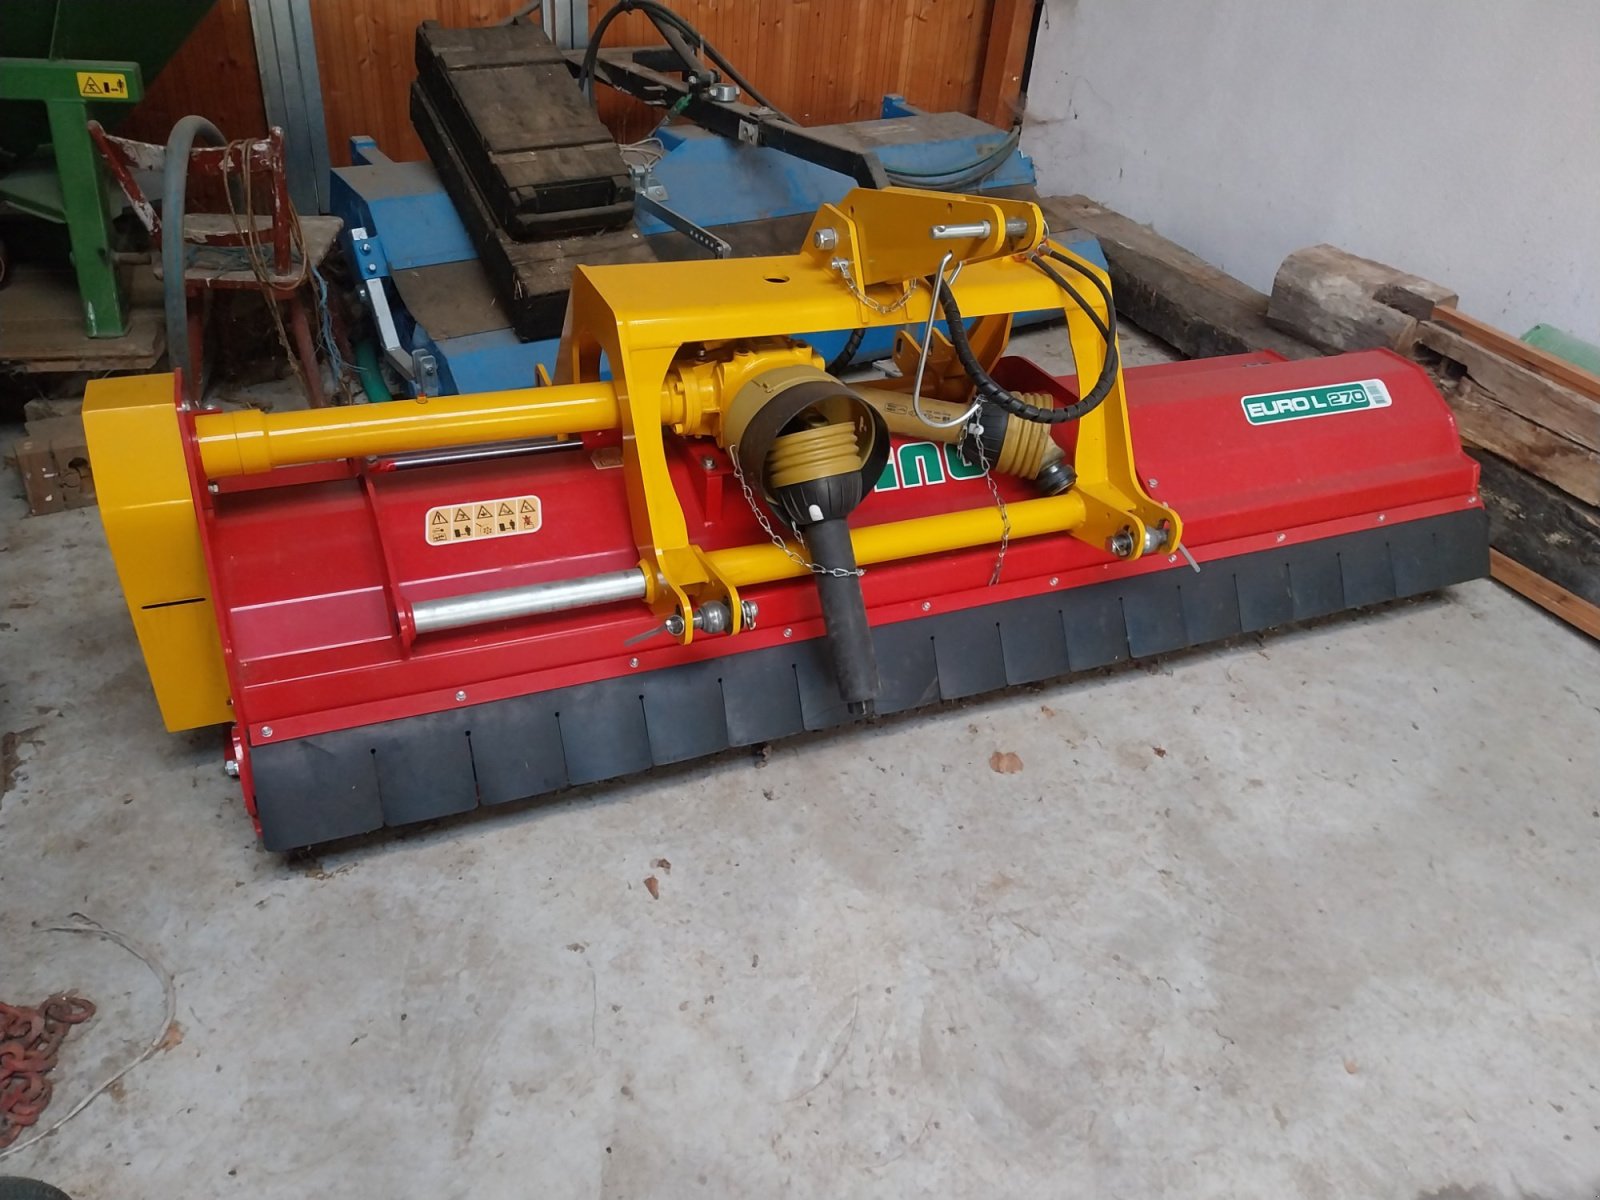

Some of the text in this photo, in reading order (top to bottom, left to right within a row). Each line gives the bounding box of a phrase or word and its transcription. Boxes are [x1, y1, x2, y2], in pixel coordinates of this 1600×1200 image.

[1247, 390, 1367, 417] EURO L 270
